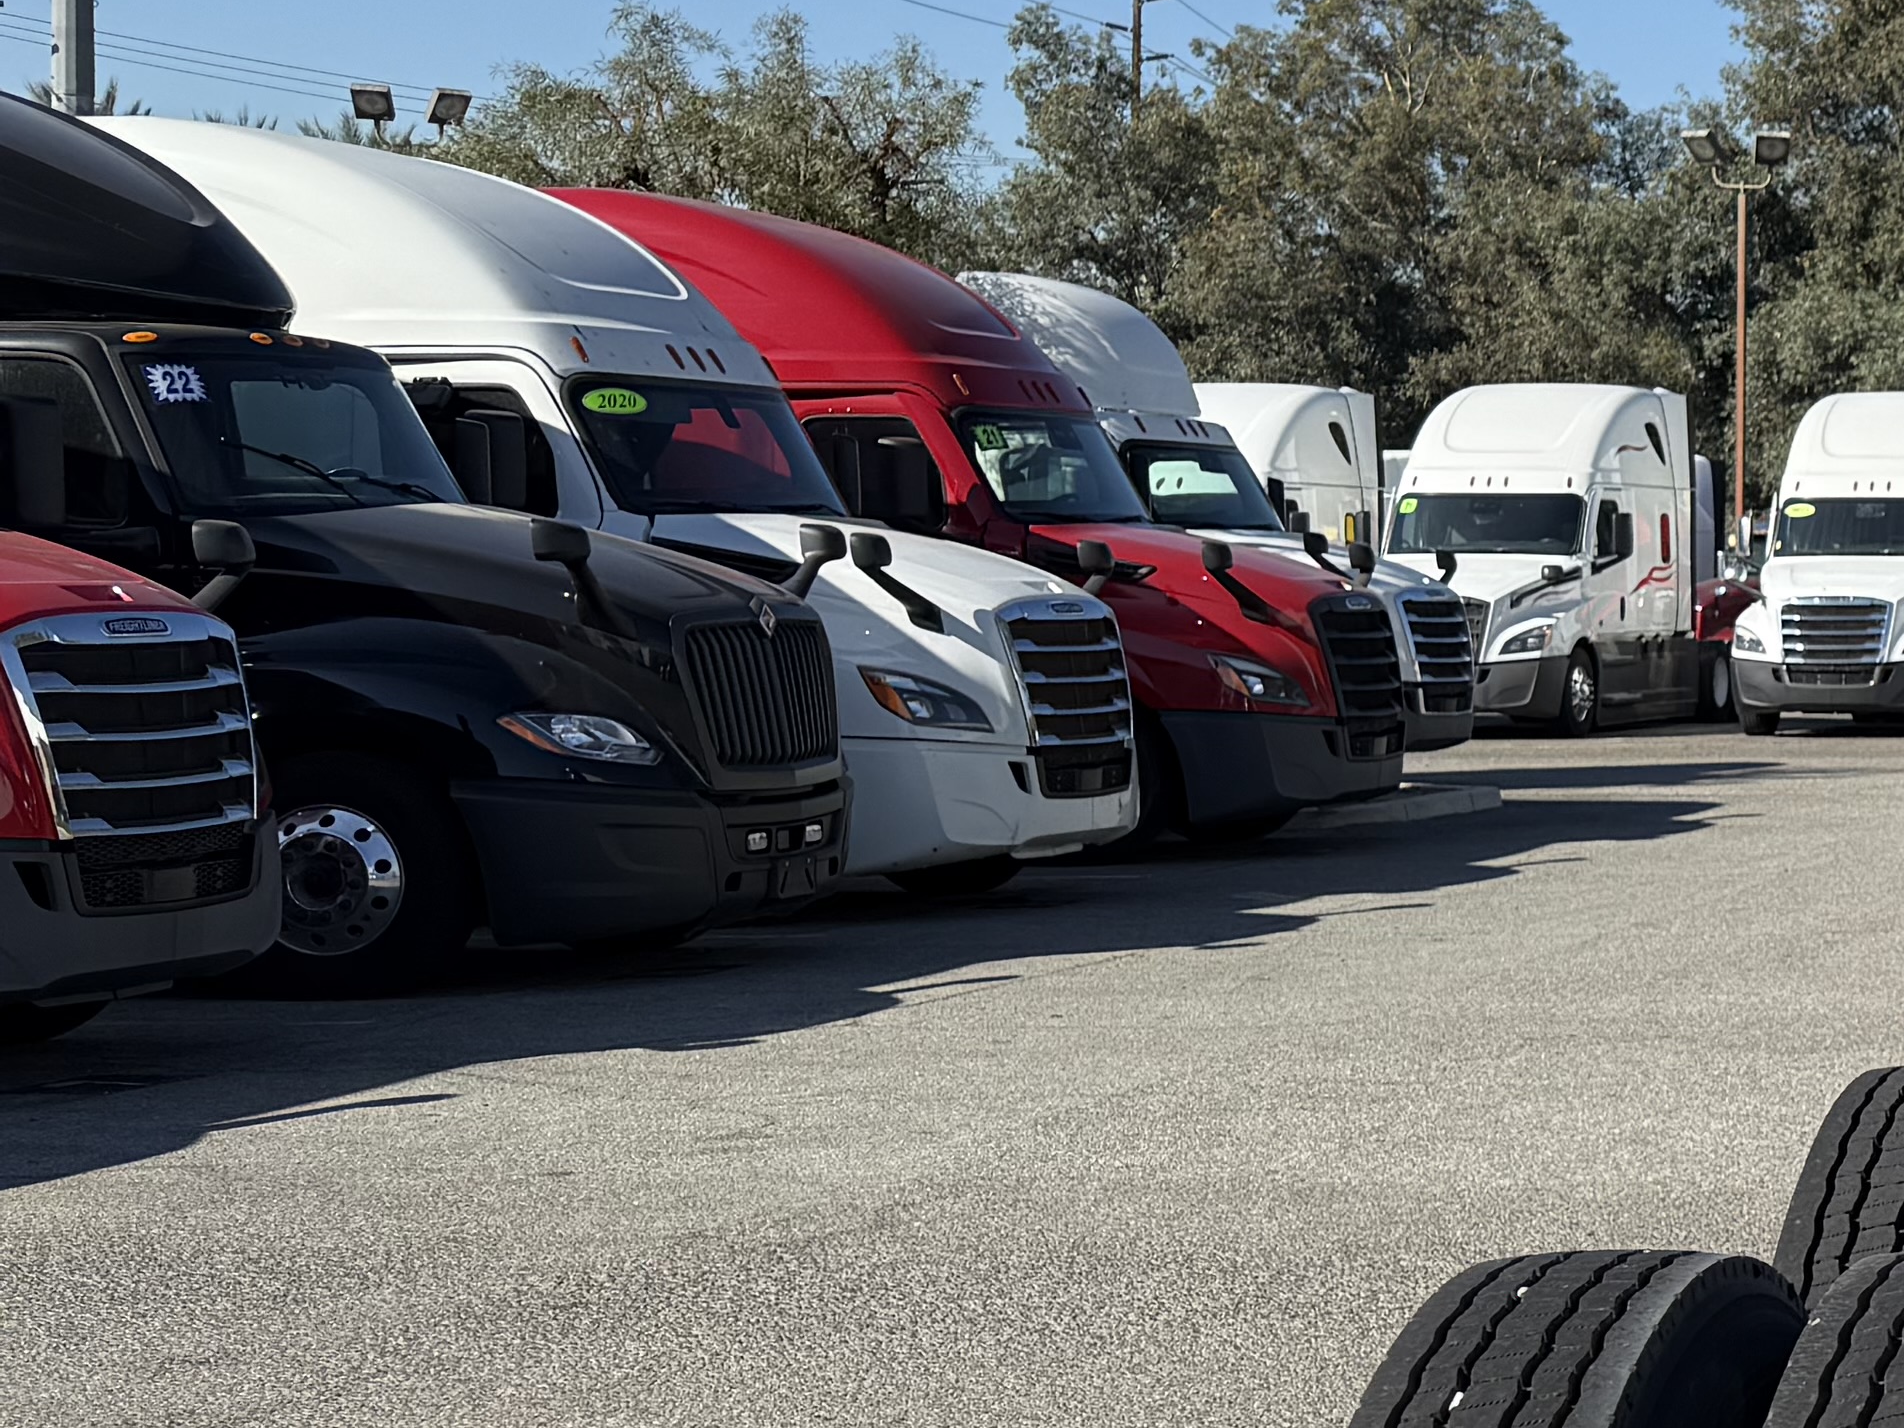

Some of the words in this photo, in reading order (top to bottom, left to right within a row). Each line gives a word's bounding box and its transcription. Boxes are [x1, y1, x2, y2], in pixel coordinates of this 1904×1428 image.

[162, 370, 196, 395] 22
[598, 393, 637, 409] 2020
[982, 427, 999, 445] 21
